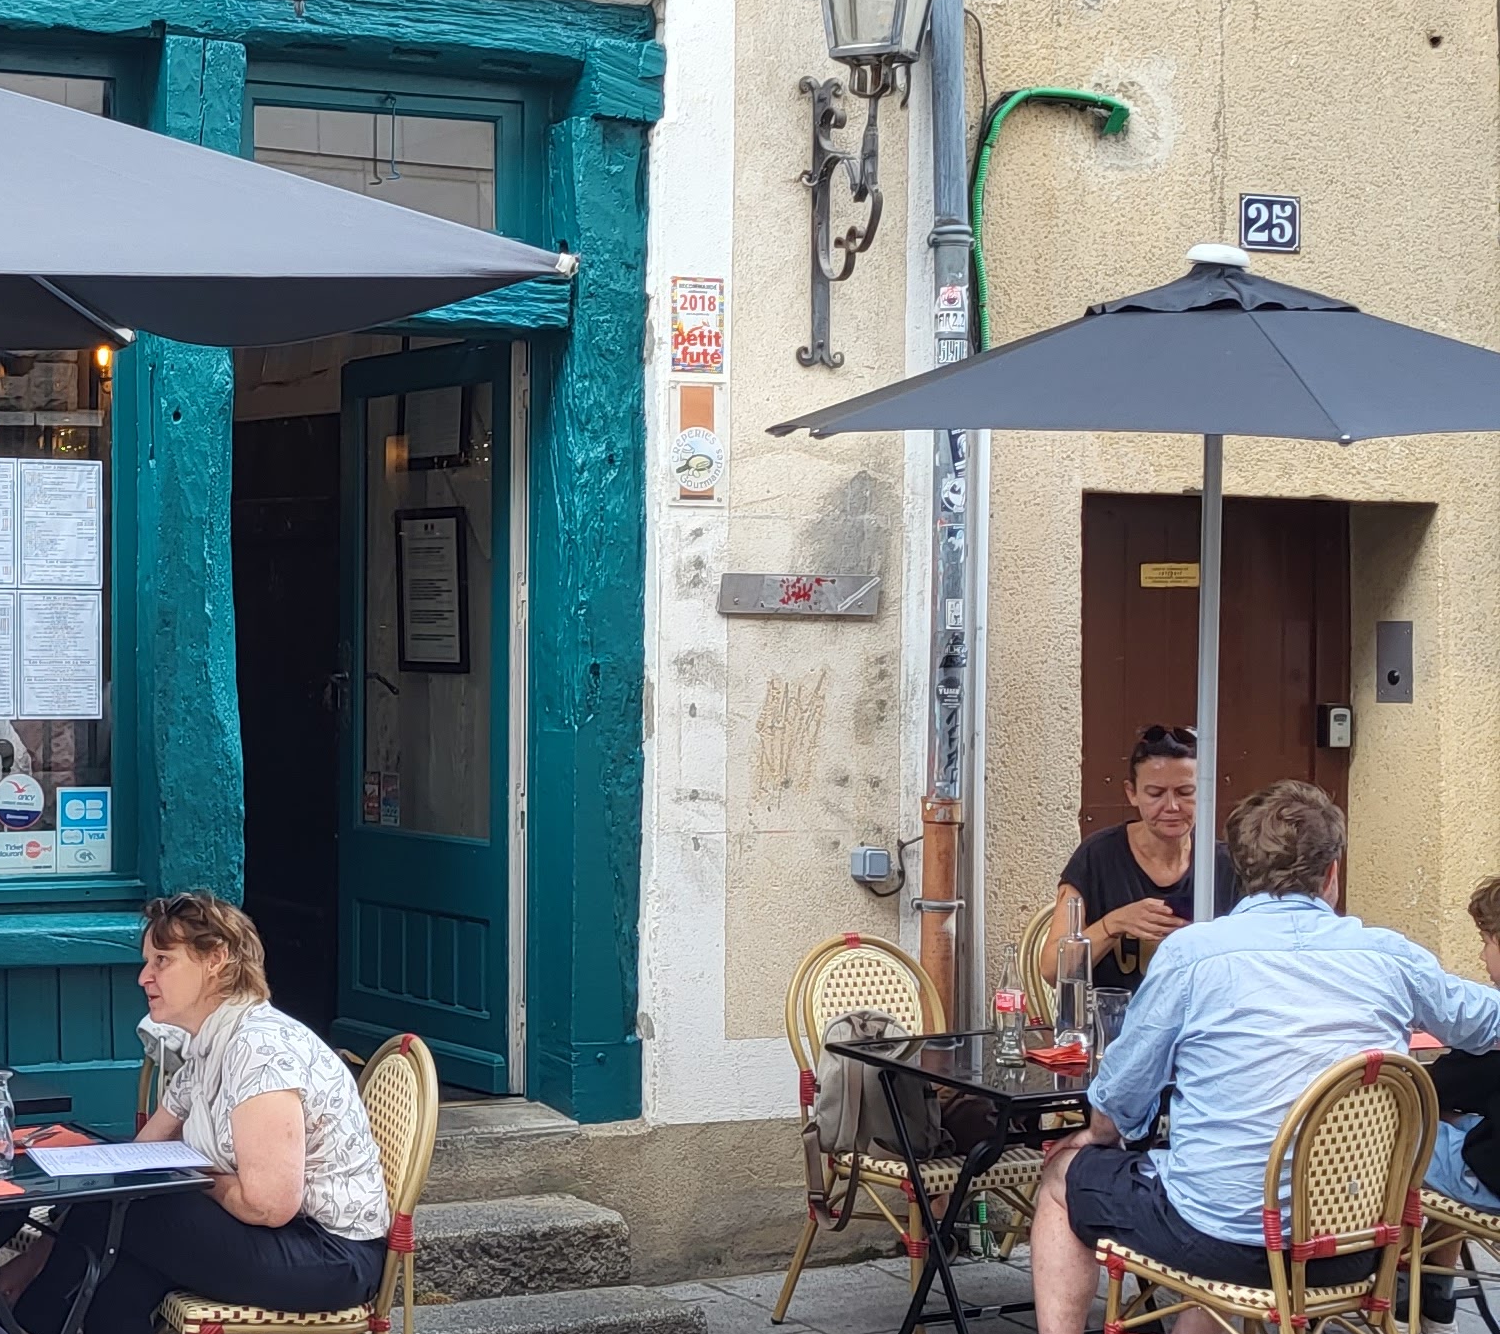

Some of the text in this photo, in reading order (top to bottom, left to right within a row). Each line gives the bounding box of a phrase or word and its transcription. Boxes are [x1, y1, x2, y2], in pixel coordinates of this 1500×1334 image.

[1247, 203, 1293, 243] 25
[679, 294, 717, 312] 2018
[681, 346, 722, 365] futé
[680, 448, 724, 489] Gourmandes
[64, 799, 104, 820] CB
